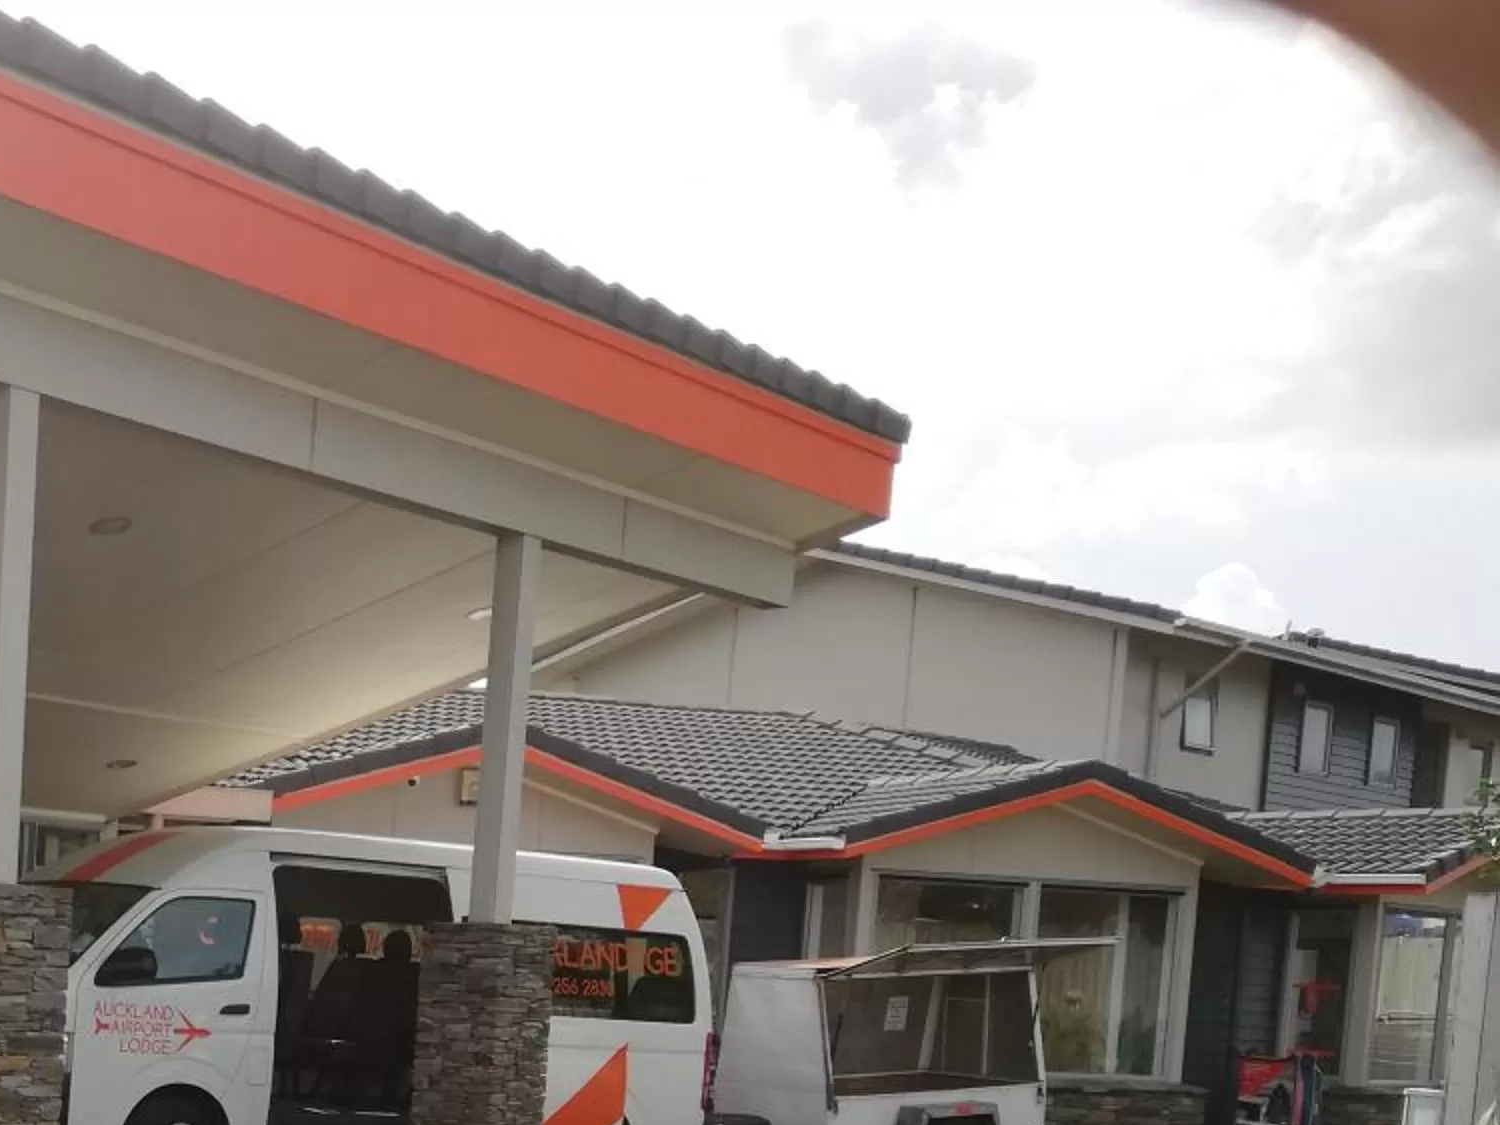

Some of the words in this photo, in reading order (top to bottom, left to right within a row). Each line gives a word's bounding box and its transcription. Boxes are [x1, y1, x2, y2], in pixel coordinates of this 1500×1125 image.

[93, 999, 174, 1021] AUCKLAND
[111, 1019, 173, 1037] AIRPORT
[118, 1038, 172, 1055] LODGE
